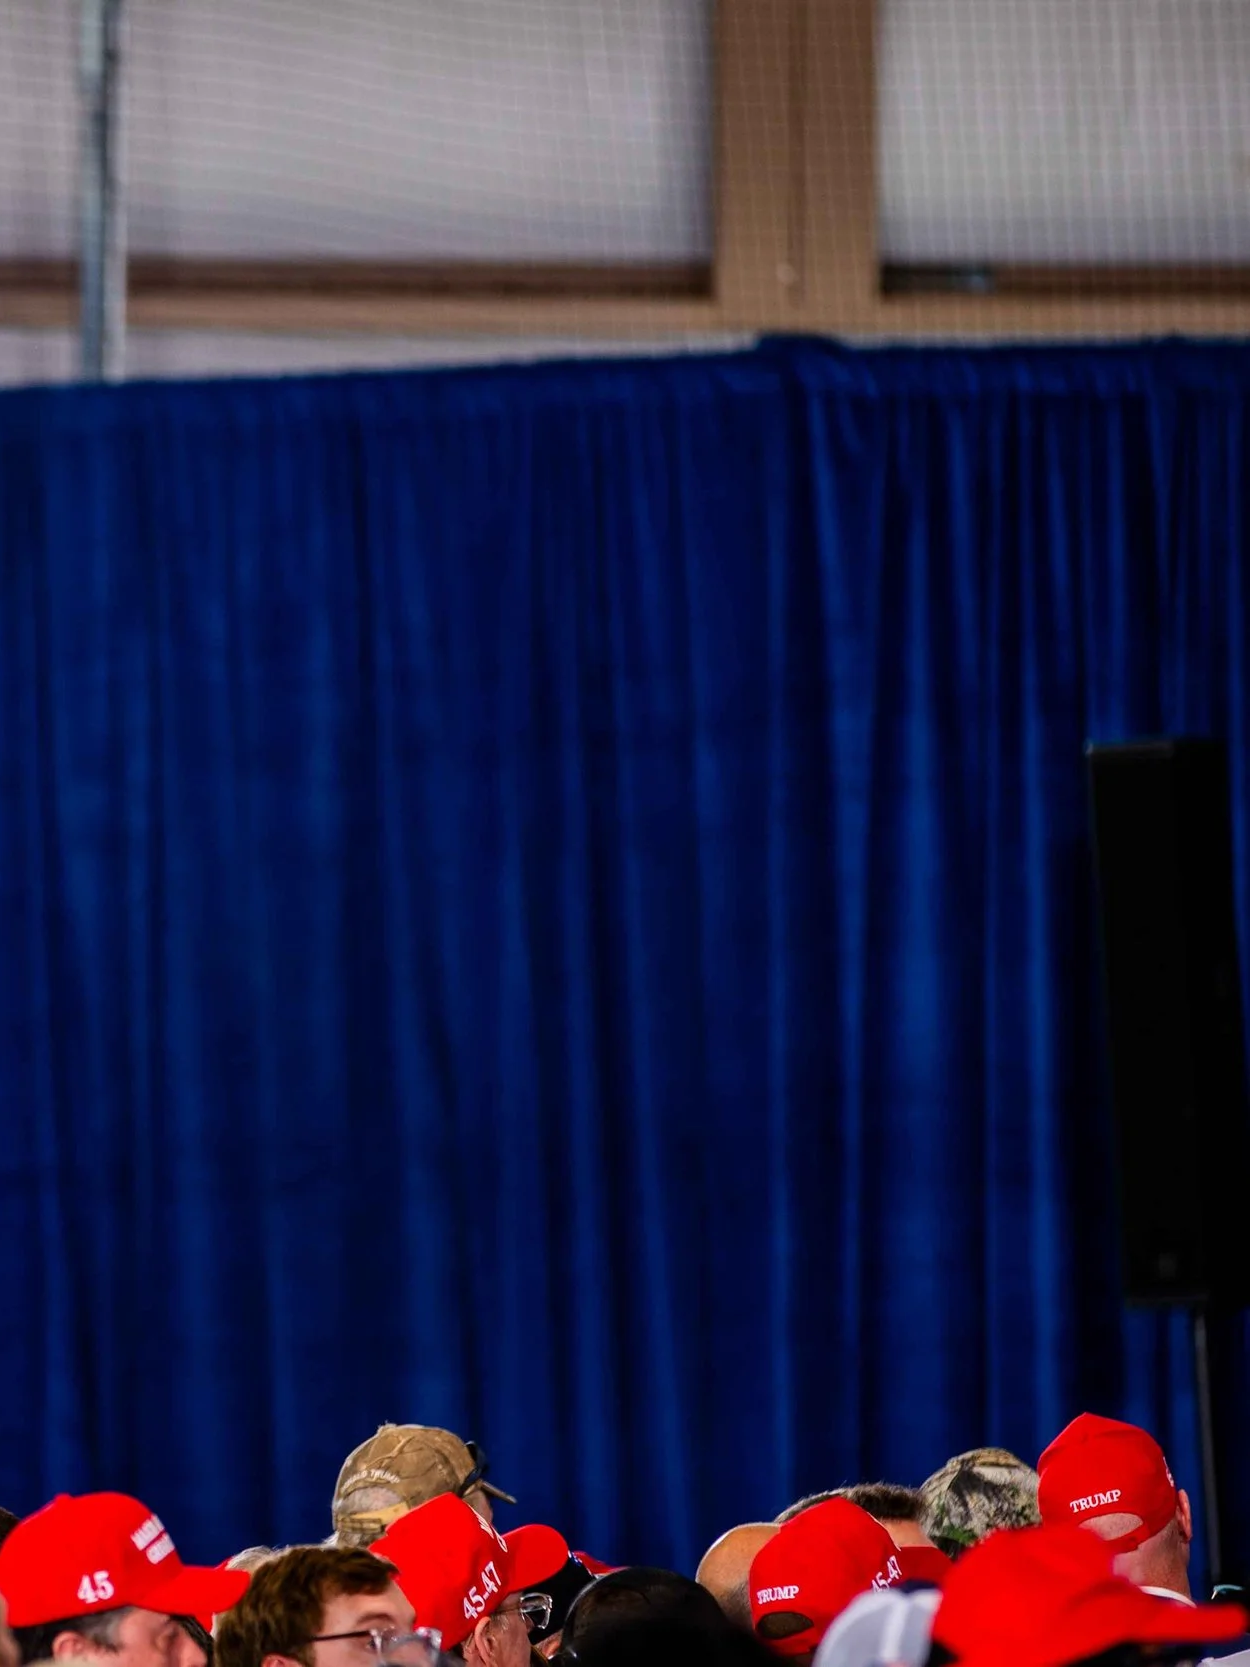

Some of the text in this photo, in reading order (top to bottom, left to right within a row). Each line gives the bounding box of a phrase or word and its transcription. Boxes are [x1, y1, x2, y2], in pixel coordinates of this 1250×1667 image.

[1069, 1489, 1121, 1513] TRUMP
[77, 1570, 115, 1604] 45
[463, 1560, 501, 1620] 45-47
[756, 1585, 800, 1605] TRUMP
